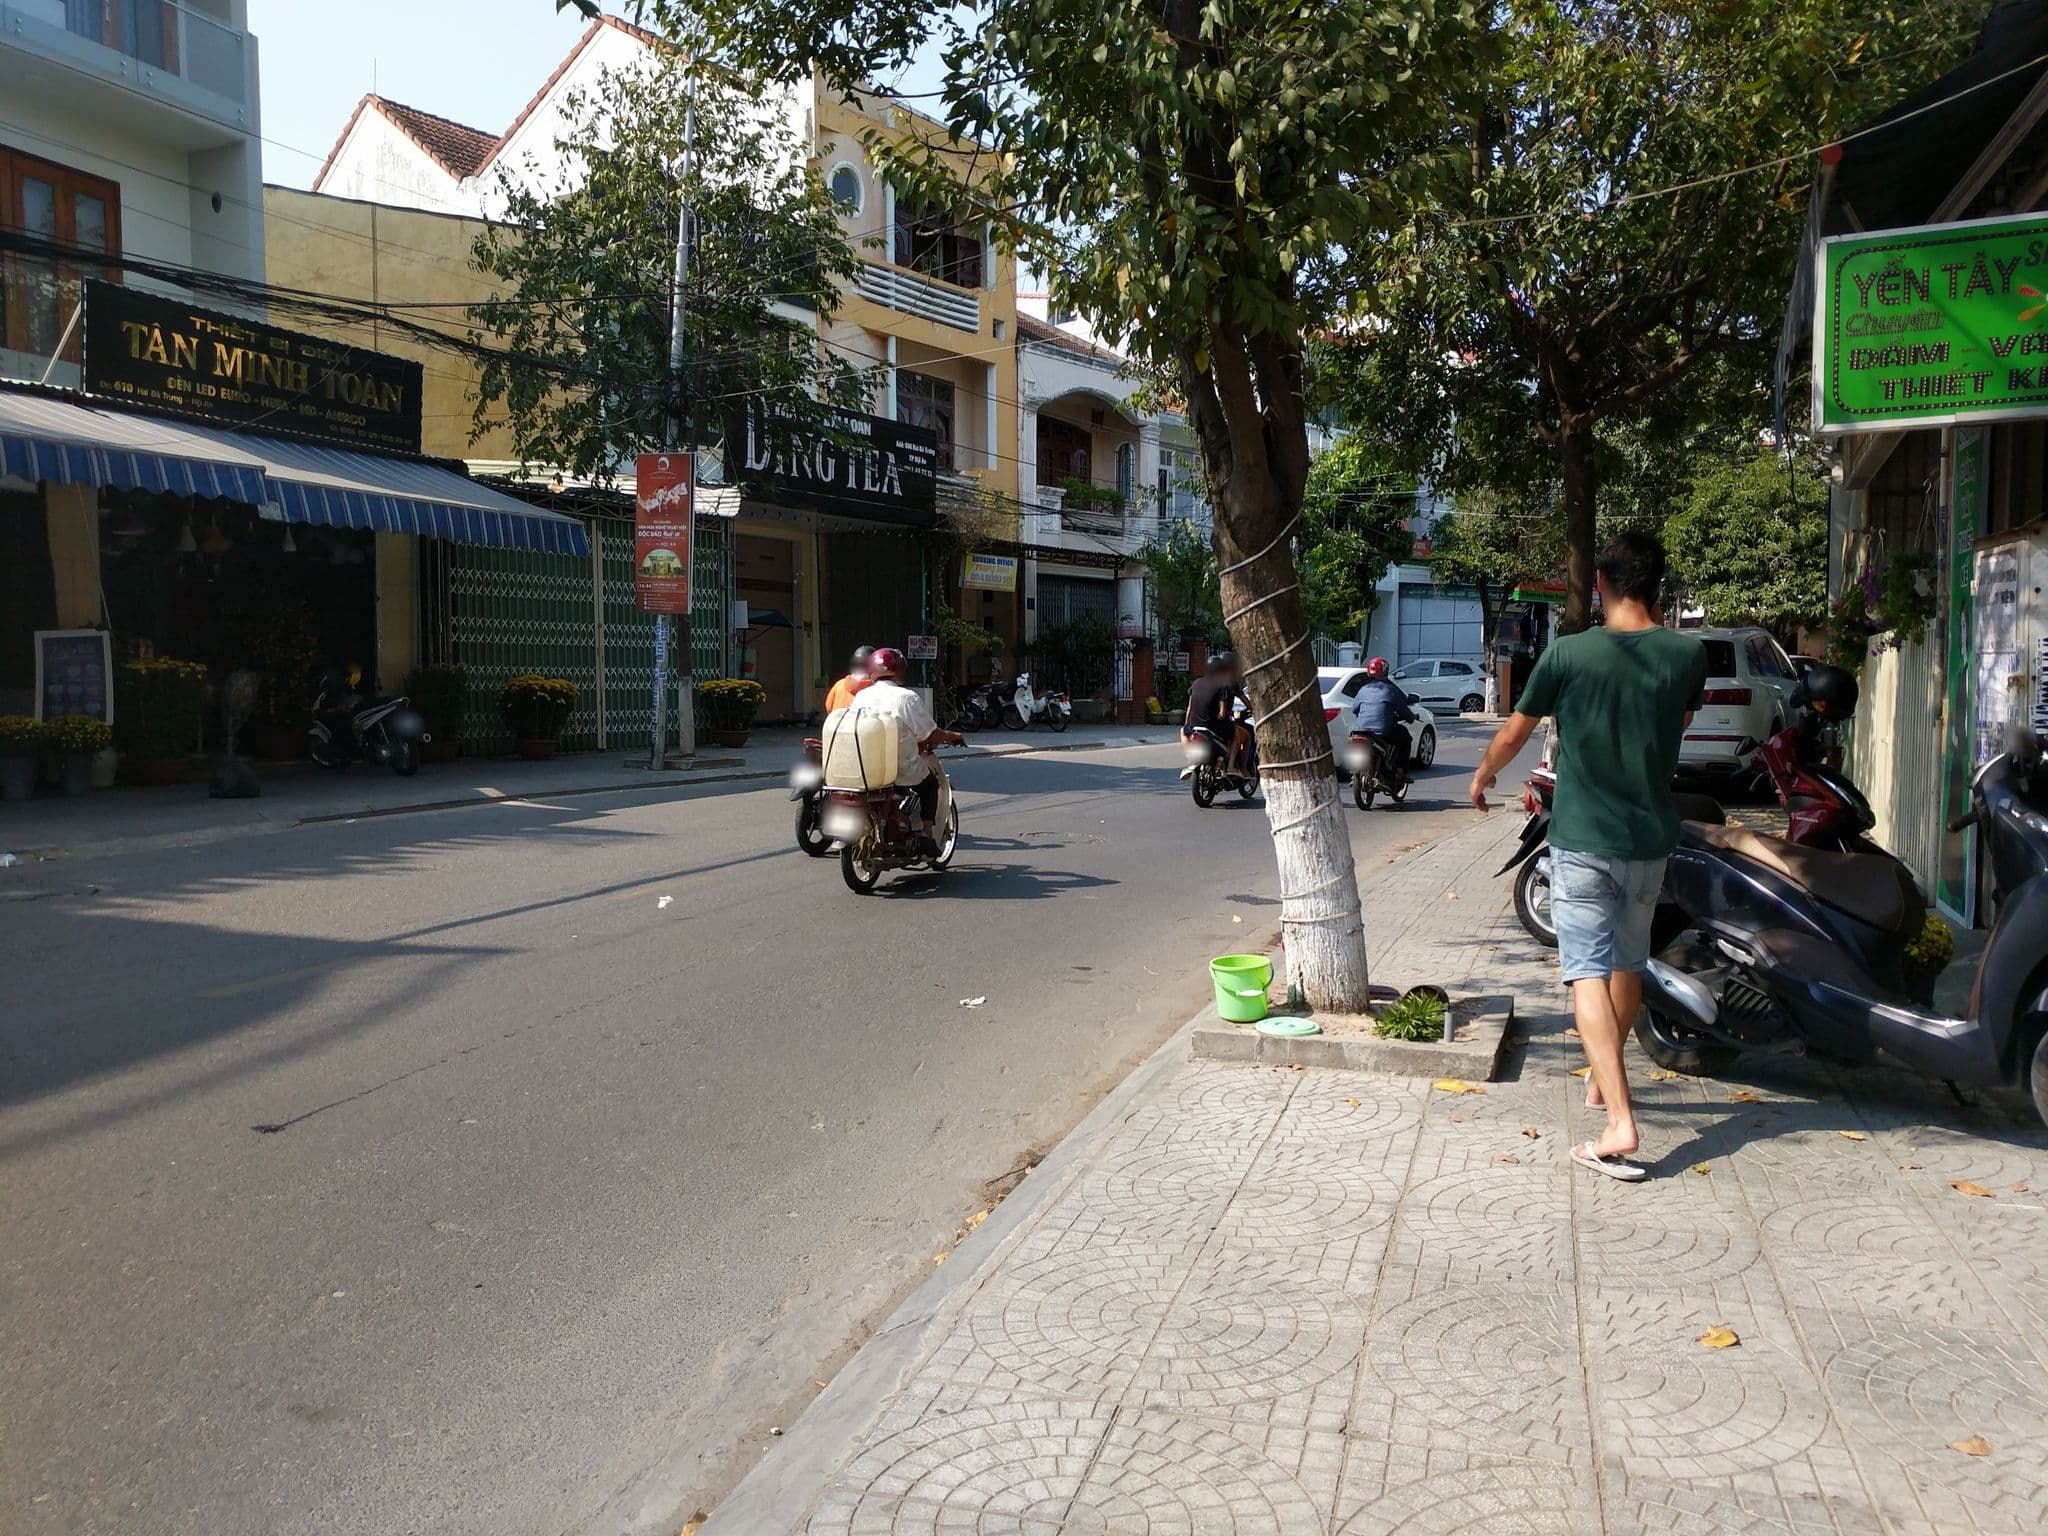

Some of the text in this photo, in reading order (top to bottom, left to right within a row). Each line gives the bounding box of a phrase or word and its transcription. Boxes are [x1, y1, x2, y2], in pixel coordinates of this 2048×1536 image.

[1852, 239, 2048, 308] YẾN TÂY S
[120, 320, 200, 370] TÂN
[211, 342, 310, 394] MINH
[1879, 360, 1993, 400] THIẾT
[196, 382, 217, 397] LED
[847, 446, 904, 497] TEA
